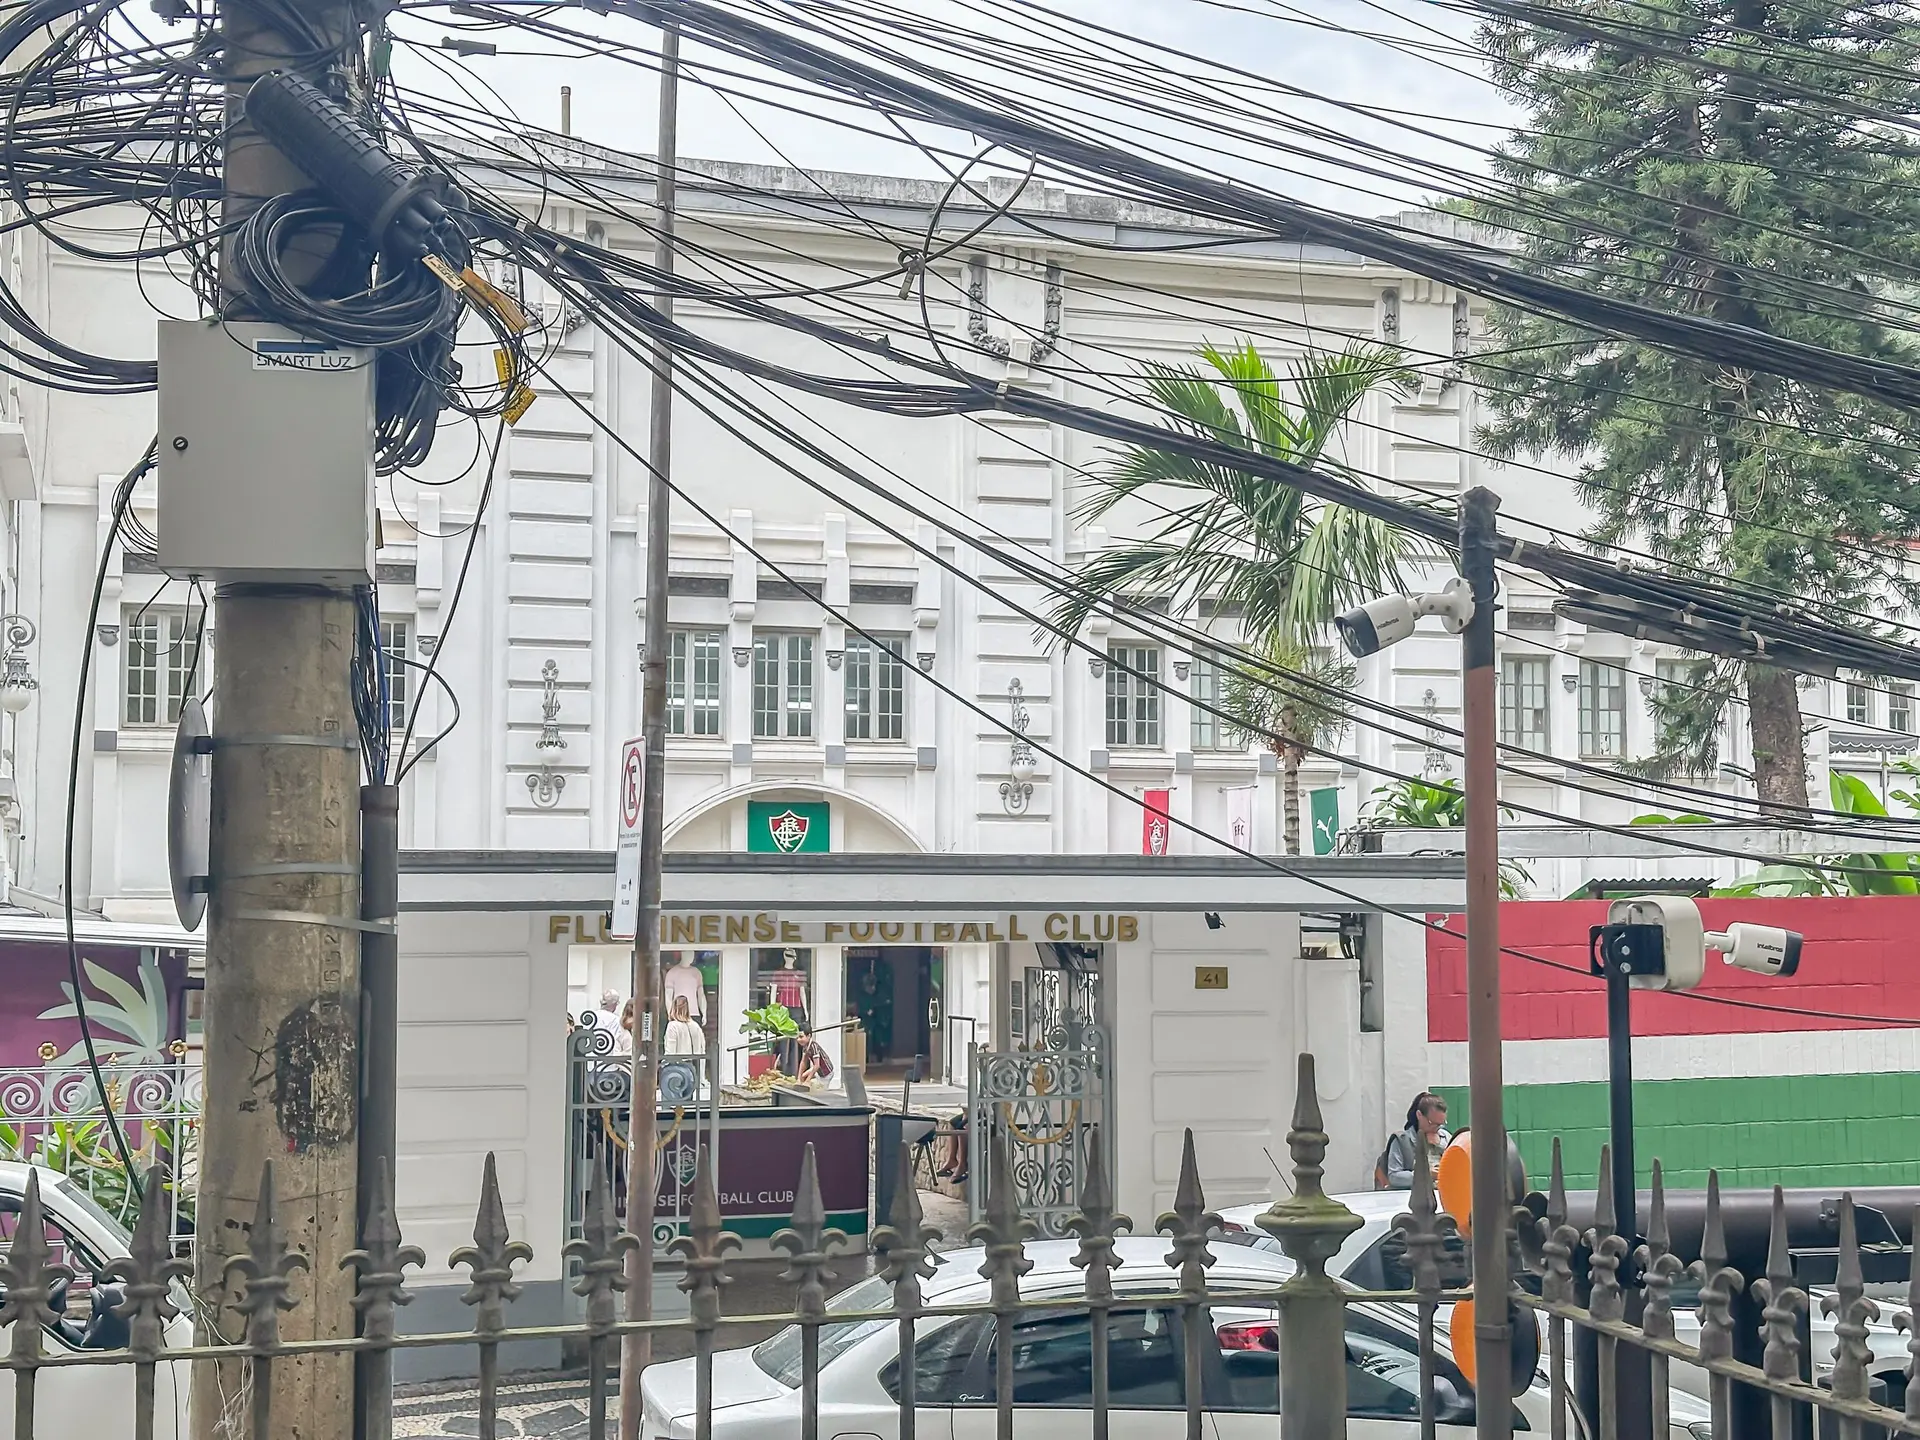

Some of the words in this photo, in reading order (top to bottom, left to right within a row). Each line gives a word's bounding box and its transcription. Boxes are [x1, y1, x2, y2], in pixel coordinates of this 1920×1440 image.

[256, 355, 315, 367] SMART
[320, 355, 352, 368] LUZ
[549, 912, 802, 943] FLINENSE
[825, 914, 1028, 942] FOOTBALL
[1045, 913, 1139, 942] CLUB
[1203, 973, 1219, 985] 41
[681, 1192, 753, 1206] FBALL
[757, 1190, 794, 1203] CLUB
